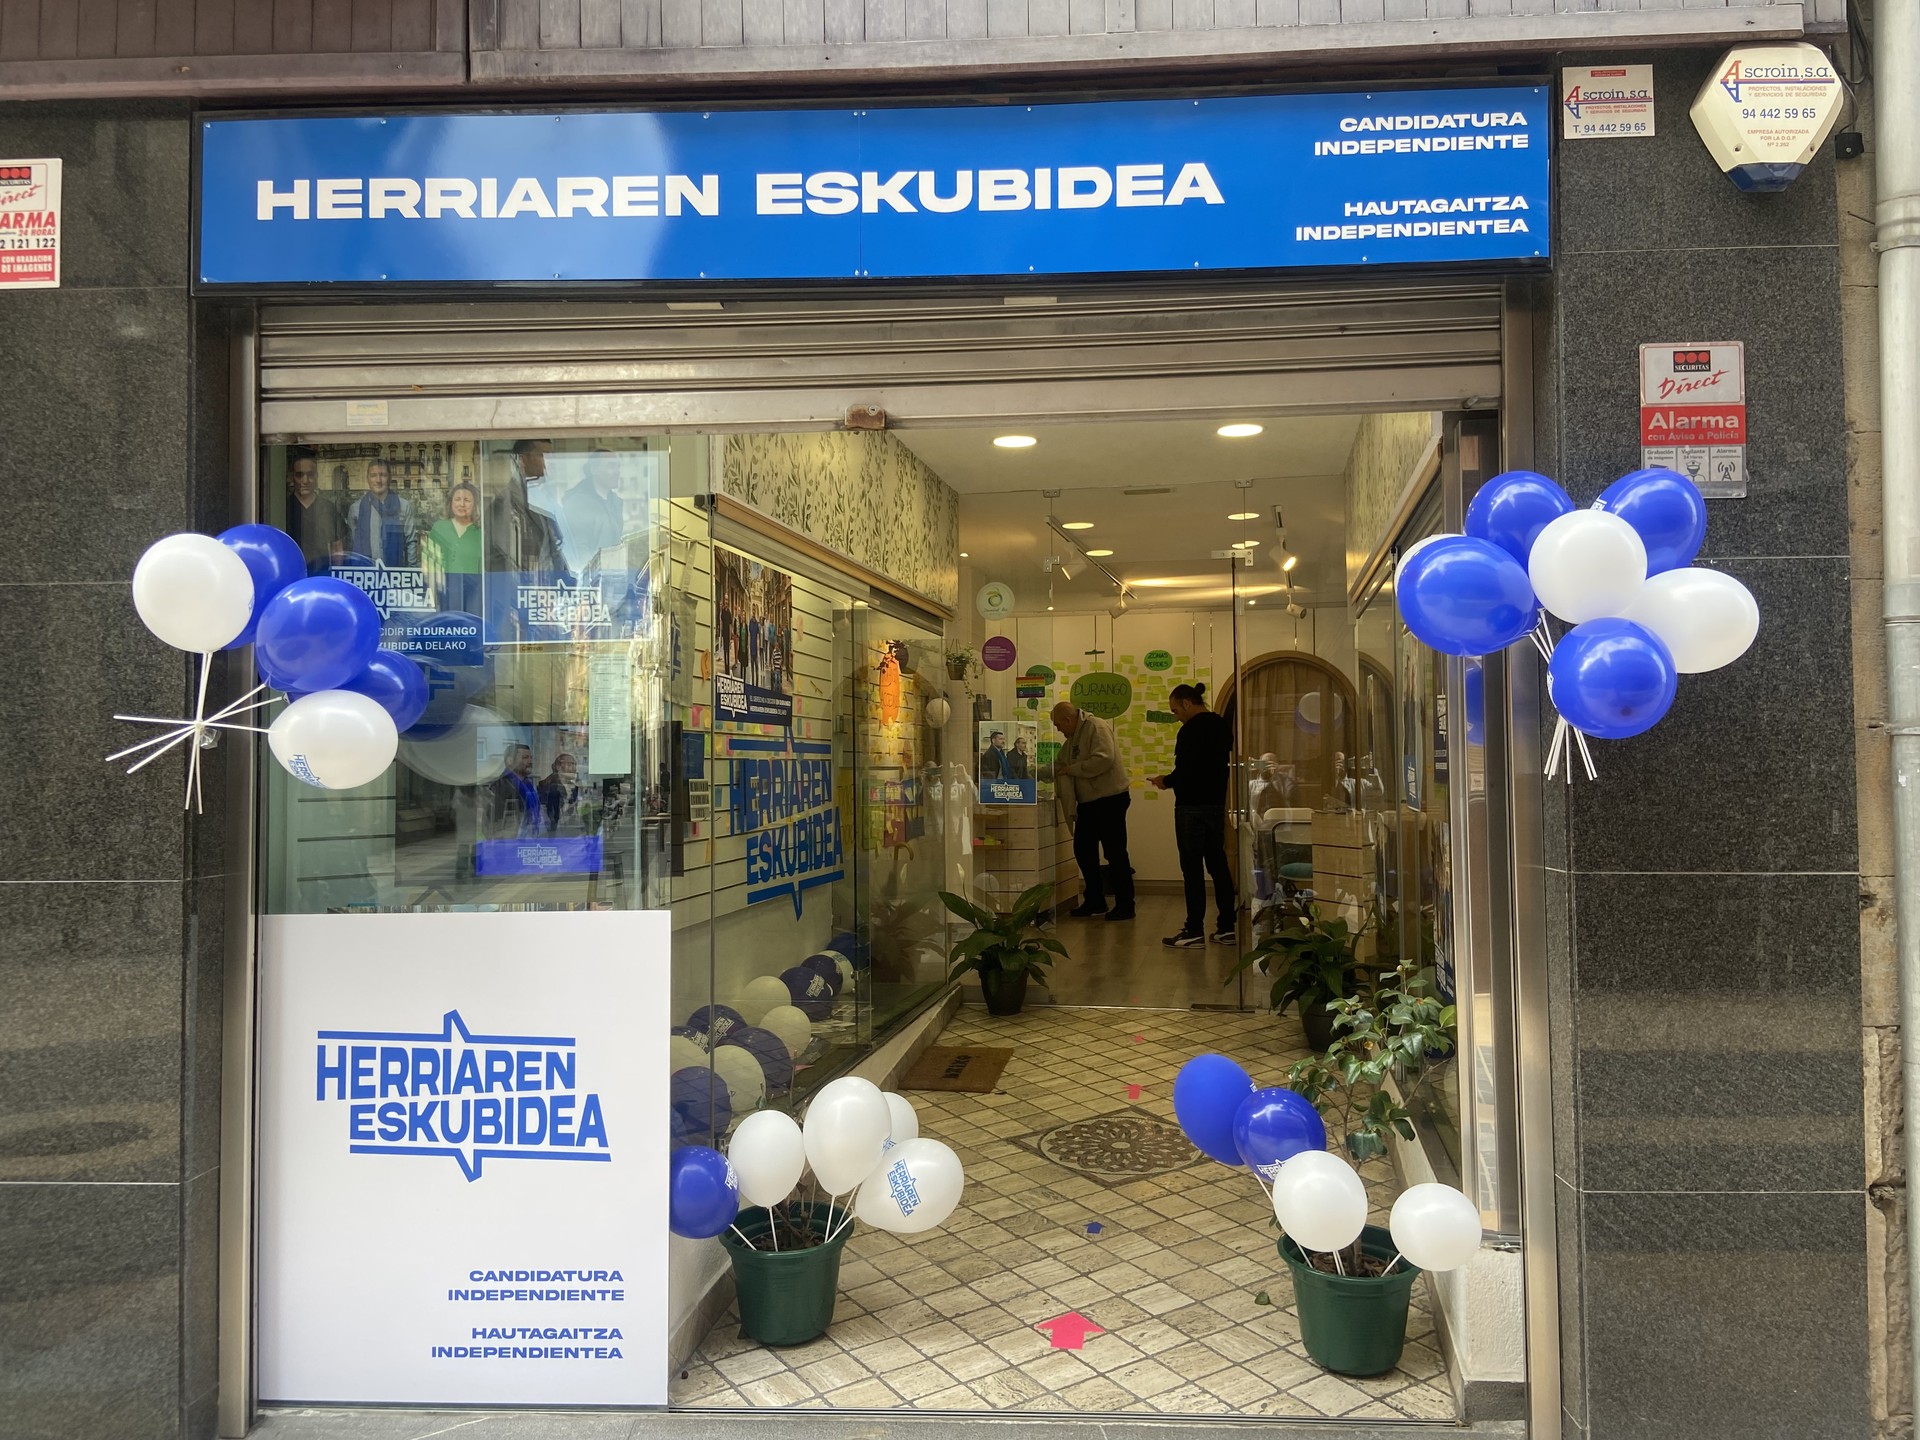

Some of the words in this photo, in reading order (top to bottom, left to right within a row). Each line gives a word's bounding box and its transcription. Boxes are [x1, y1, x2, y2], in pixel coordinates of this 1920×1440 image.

[1340, 112, 1528, 132] CANDIDATURA
[1742, 108, 1756, 119] 94
[1760, 108, 1781, 119] 442
[1785, 108, 1799, 119] 59
[1802, 108, 1816, 119] 65
[1573, 125, 1581, 133] T.
[1584, 124, 1596, 133] 94
[1599, 123, 1617, 132] 442
[1620, 123, 1631, 131] 59
[1634, 122, 1646, 131] 65
[1314, 134, 1529, 156] INDEPENDIENTE
[0, 184, 44, 205] irect
[257, 175, 719, 220] HERRIAREN
[756, 162, 1226, 215] ESKUBIDEA
[1344, 196, 1529, 217] HAUTAGAITZA
[0, 211, 56, 229] ARMA
[1296, 218, 1529, 241] INDEPENDIENTEA
[11, 239, 29, 248] 121
[36, 238, 56, 248] 122
[1658, 369, 1730, 399] Direct
[1648, 411, 1739, 429] Alarma
[1668, 432, 1695, 440] Aviso
[1707, 430, 1739, 439] Policía
[517, 590, 601, 608] HERRIAREN
[528, 604, 611, 622] ESKUBIDEA
[380, 627, 404, 636] CIDIR
[406, 627, 422, 636] EN
[424, 627, 477, 636] DURANGO
[425, 641, 466, 650] DELAKO
[1074, 683, 1128, 696] DURANGO
[729, 758, 832, 837] HERRIAREN
[746, 806, 844, 886] ESKUBIDEA
[316, 1044, 576, 1101] HERRIAREN
[349, 1093, 609, 1148] ESKUBIDEA
[893, 1160, 919, 1207] HERRIAREN
[889, 1170, 914, 1217] ESKUBIDEA
[468, 1269, 624, 1283] CANDIDATURA
[448, 1289, 624, 1302] INDEPENDIENTE
[471, 1327, 624, 1340] HAUTAGAITZA
[431, 1346, 624, 1359] INDEPENDIENTEA
